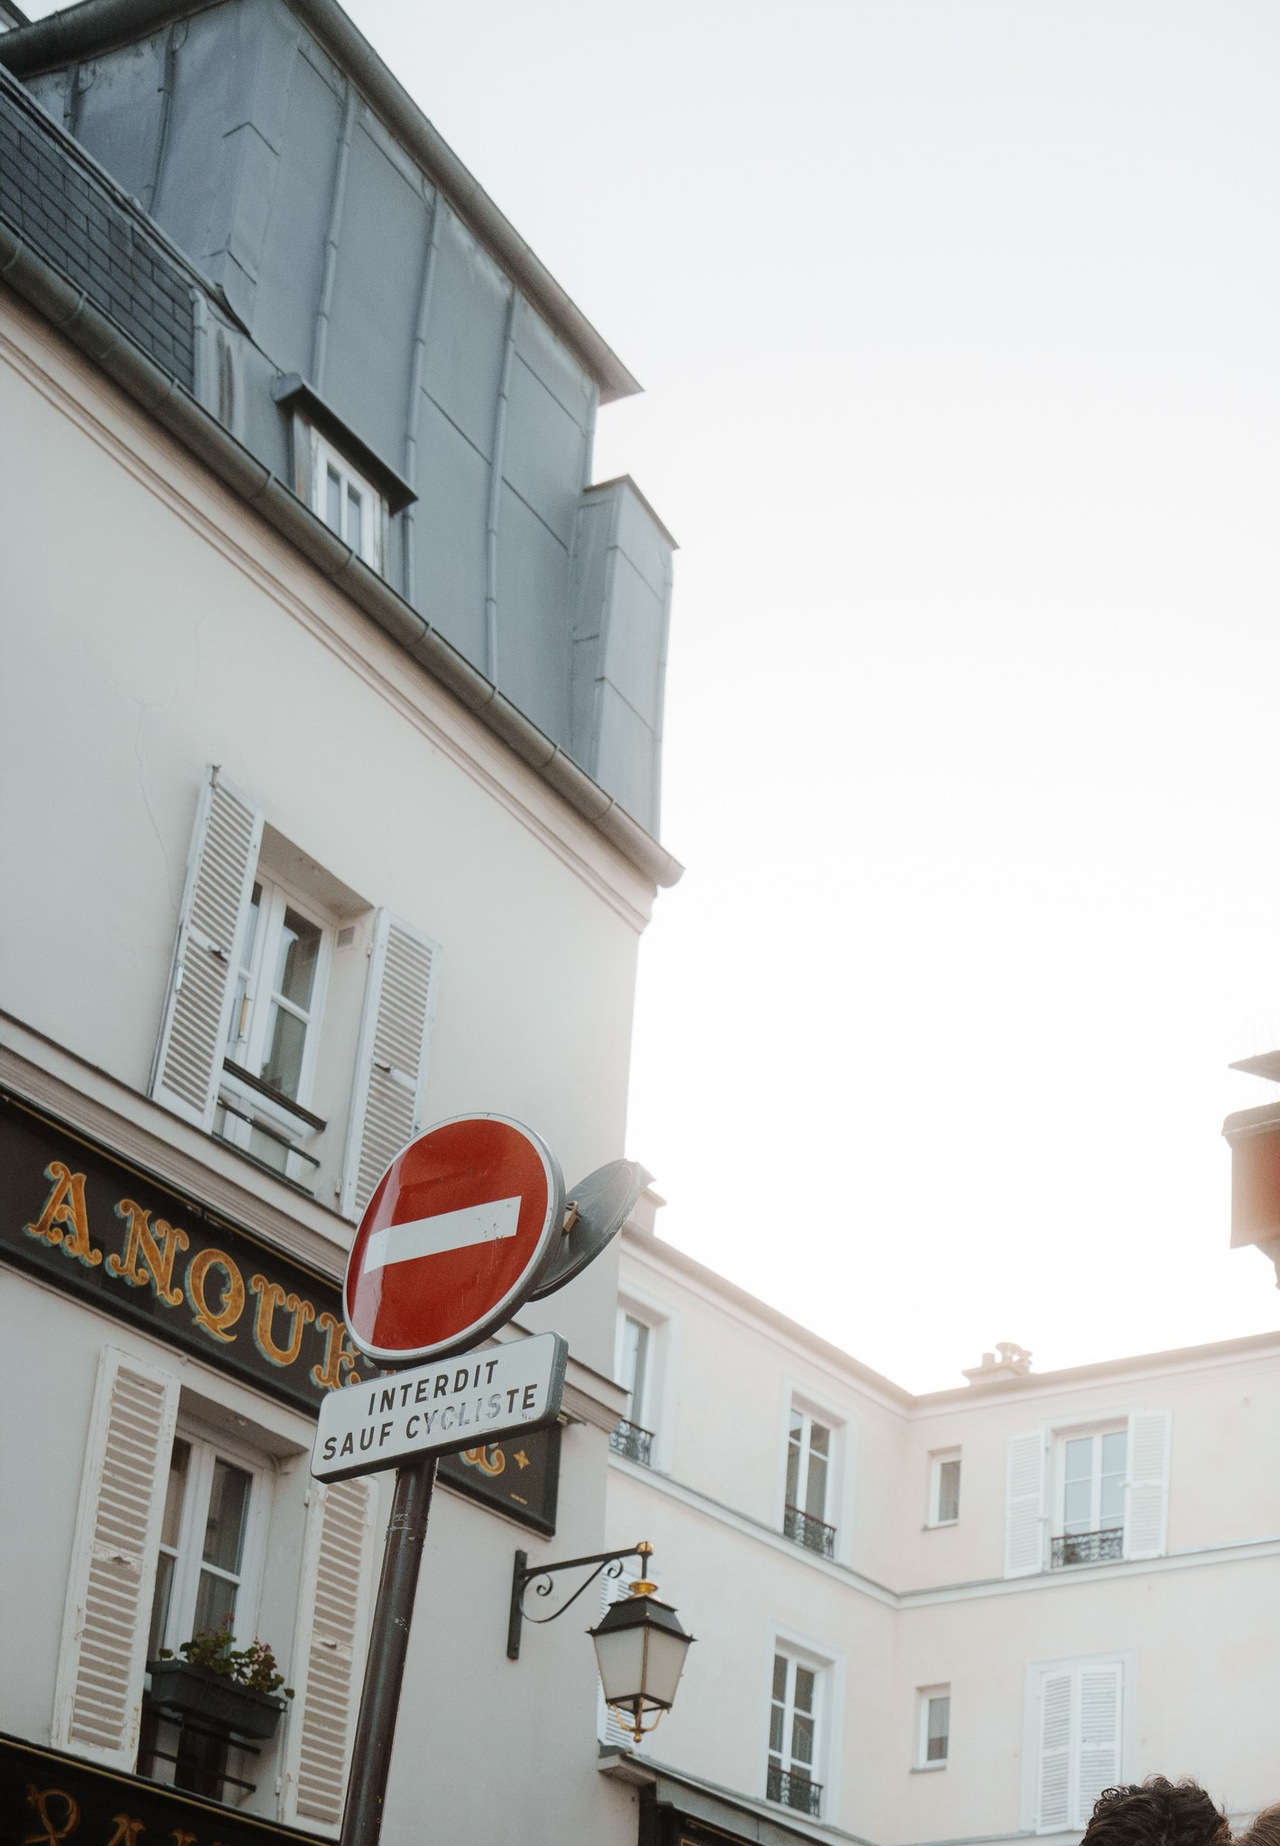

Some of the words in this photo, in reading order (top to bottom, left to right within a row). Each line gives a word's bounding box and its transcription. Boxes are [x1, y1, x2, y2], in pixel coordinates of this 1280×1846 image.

[368, 1359, 499, 1416] INTERDIT
[321, 1421, 394, 1461] SAUF
[405, 1383, 538, 1439] CYCLISTE
